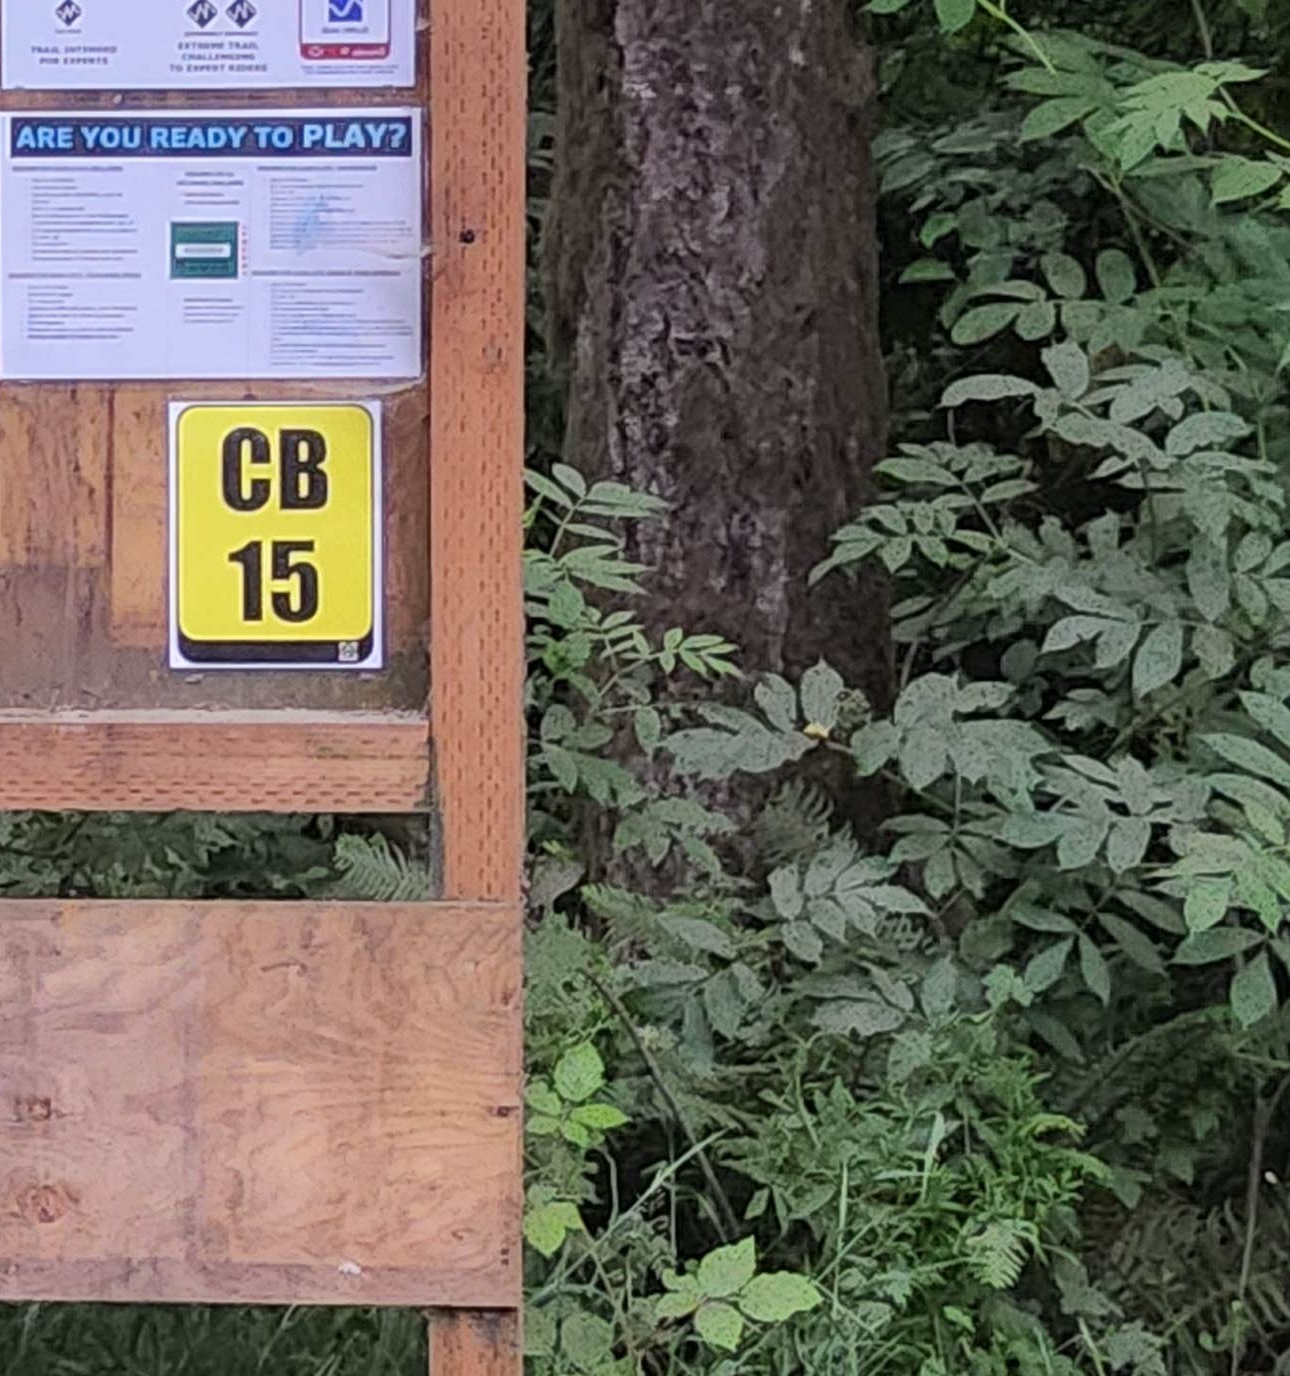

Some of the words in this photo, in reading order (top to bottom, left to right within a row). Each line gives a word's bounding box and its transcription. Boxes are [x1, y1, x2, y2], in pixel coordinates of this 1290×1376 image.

[16, 126, 74, 149] ARE
[81, 126, 142, 149] YOU
[150, 126, 246, 149] READY
[253, 125, 294, 148] TO
[303, 123, 407, 149] PLAY?
[221, 427, 328, 512] CB
[228, 540, 319, 623] 15
